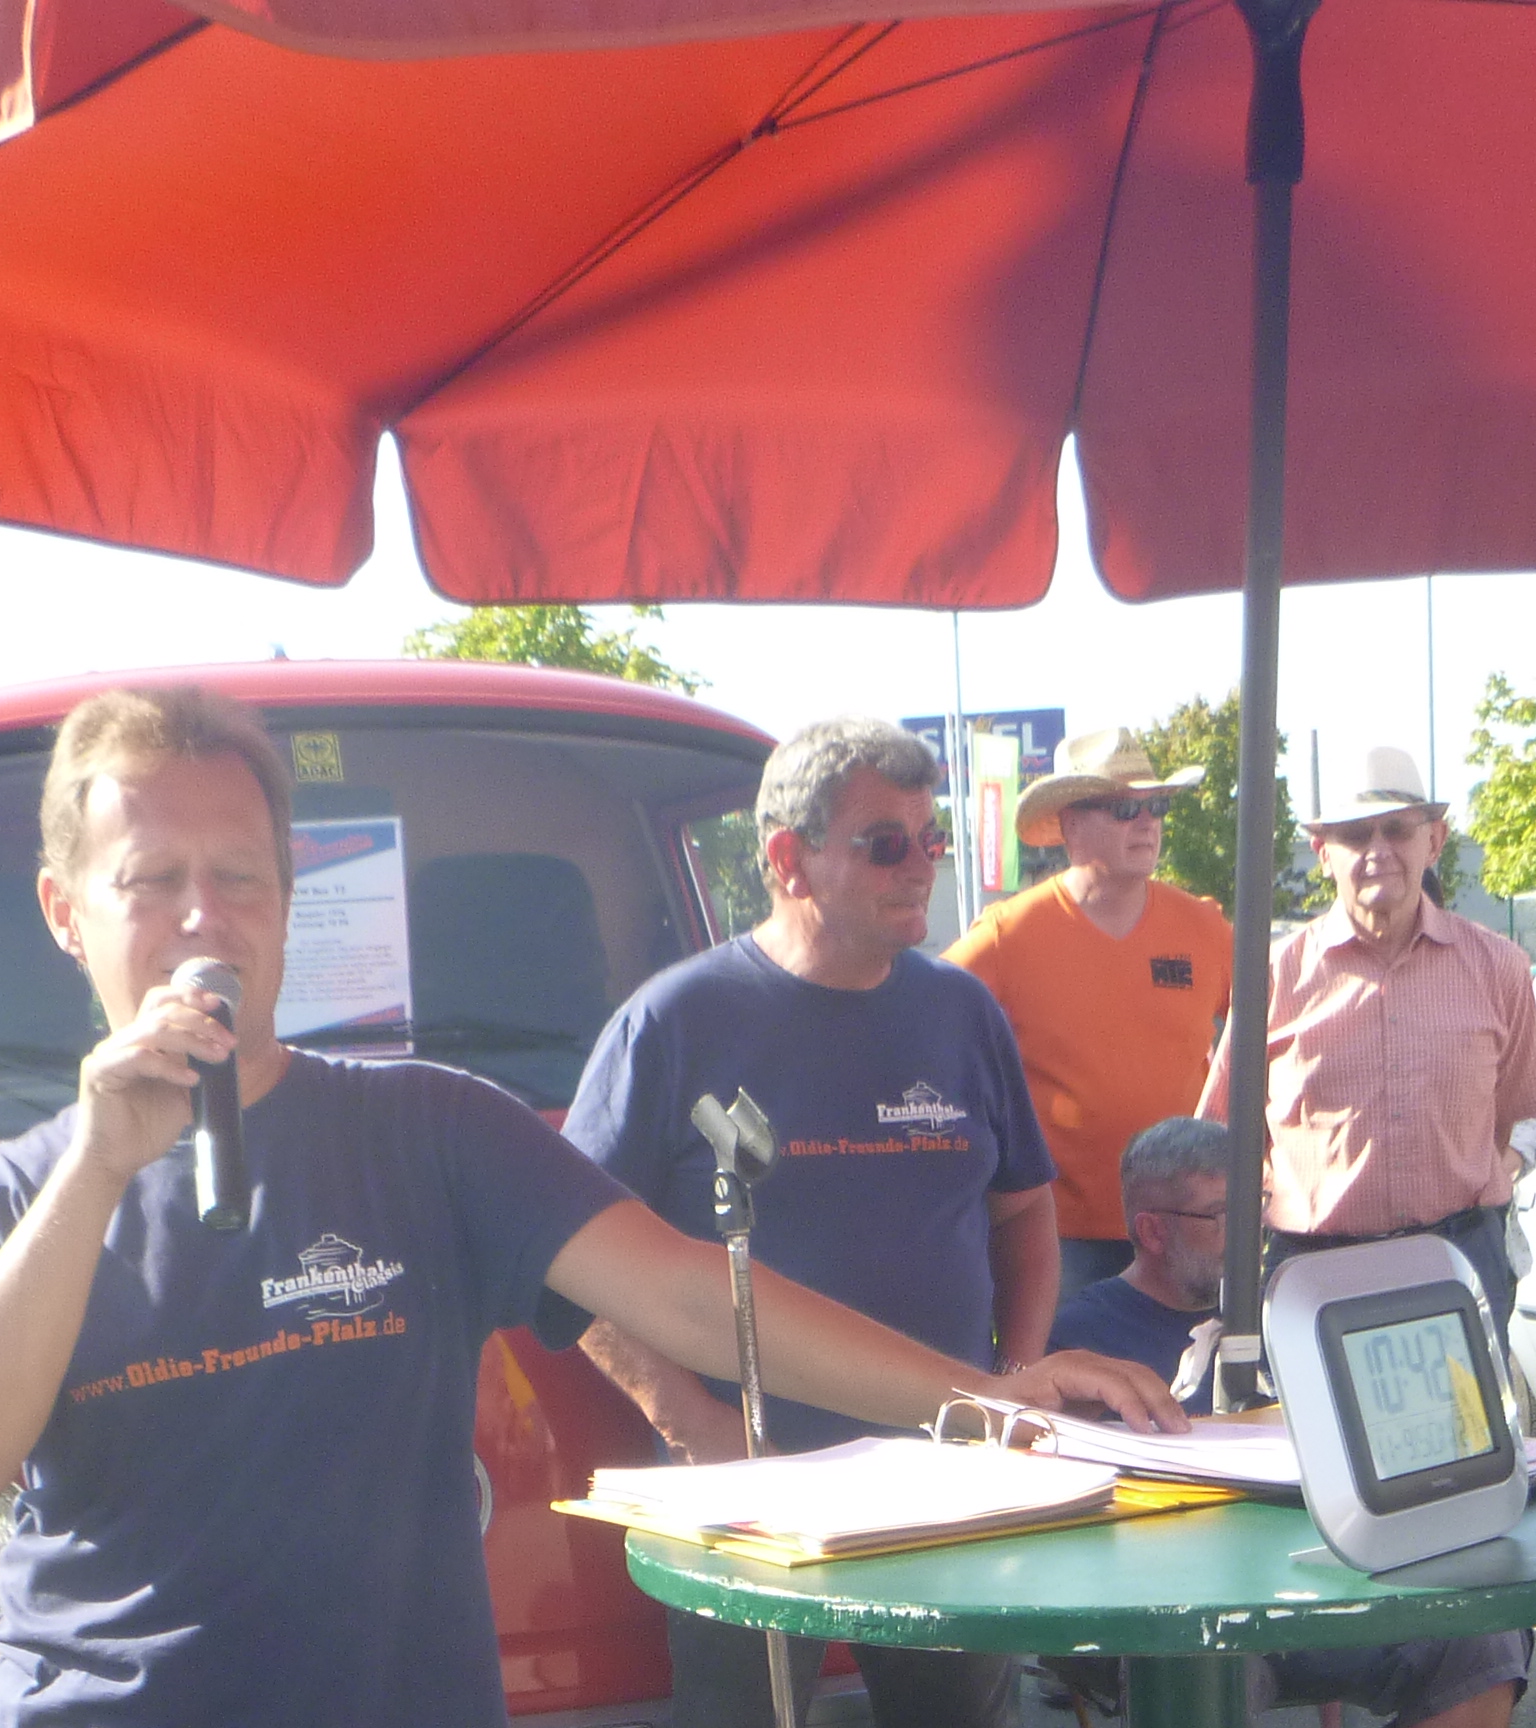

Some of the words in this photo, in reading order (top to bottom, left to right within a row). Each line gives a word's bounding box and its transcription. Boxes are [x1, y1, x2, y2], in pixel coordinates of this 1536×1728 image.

[780, 1136, 970, 1157] .Oldie-Freunde-Pfalz.de
[261, 1259, 385, 1300] Frankenthal
[70, 1311, 407, 1403] www.Oldie-Freunde-Pfalz.de
